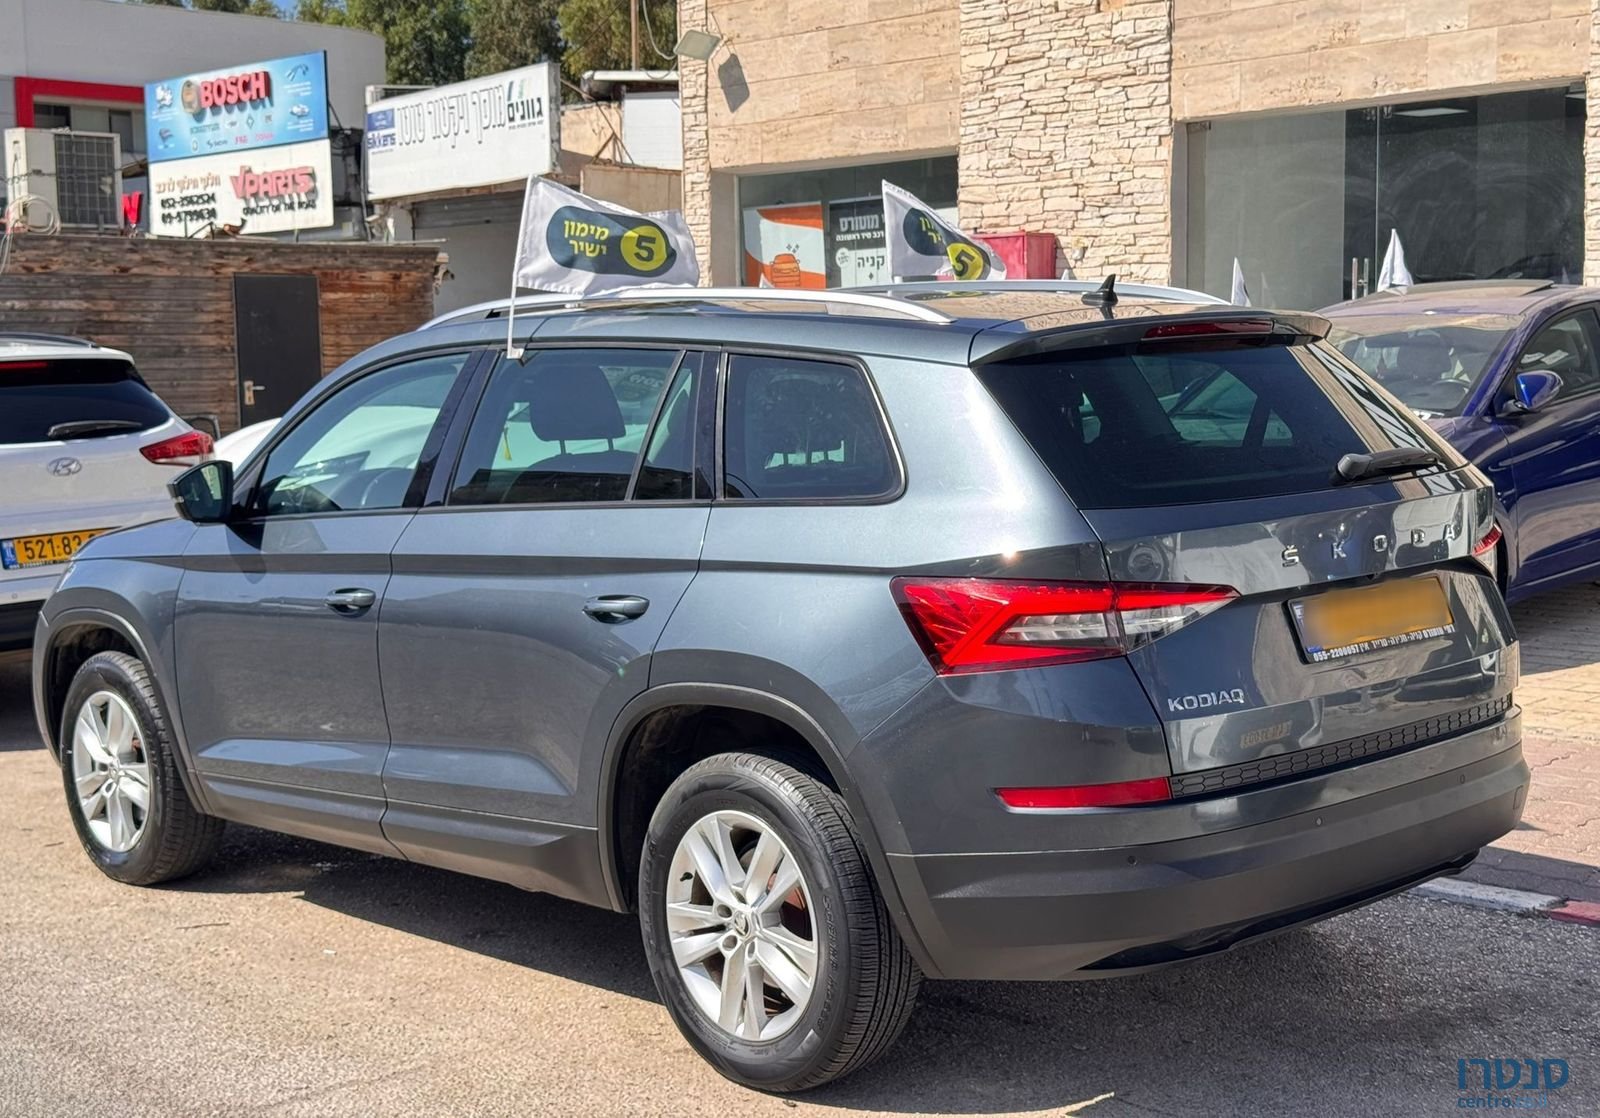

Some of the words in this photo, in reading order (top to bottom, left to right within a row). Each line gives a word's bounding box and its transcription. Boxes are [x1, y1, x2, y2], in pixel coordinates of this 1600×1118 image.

[200, 71, 268, 108] BOSCH
[507, 97, 543, 122] גוונים
[564, 220, 609, 240] מימון
[839, 214, 880, 231] מוטורס
[569, 239, 607, 257] ישיר
[634, 234, 656, 262] 5
[857, 255, 885, 270] קניה
[955, 249, 976, 275] 5
[1167, 688, 1245, 712] KODIAQ
